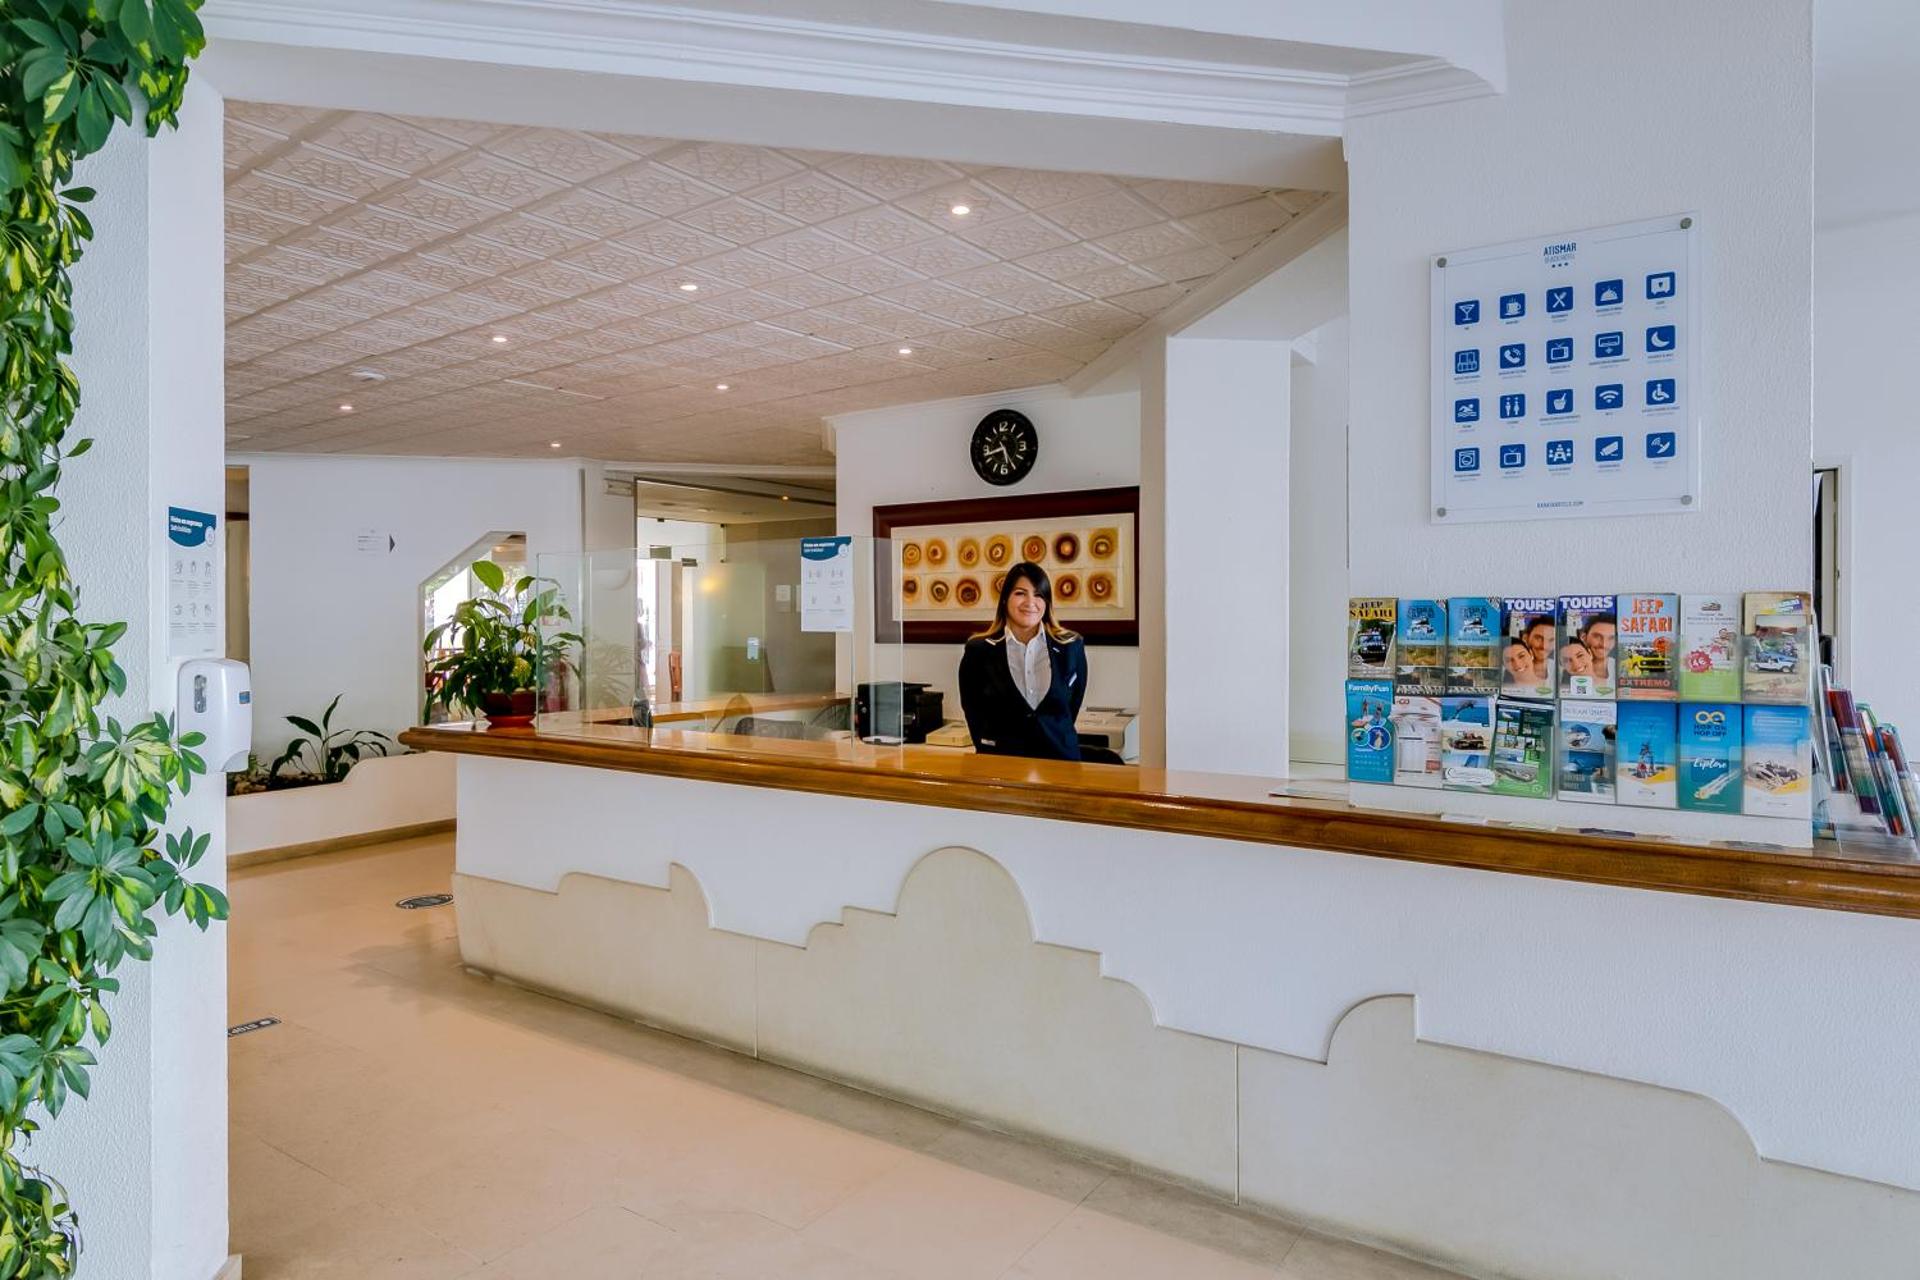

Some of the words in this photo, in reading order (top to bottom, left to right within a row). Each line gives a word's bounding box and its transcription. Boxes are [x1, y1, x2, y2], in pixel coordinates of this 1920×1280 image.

[1544, 242, 1577, 256] ATISMAR
[999, 421, 1009, 432] 12
[1019, 441, 1027, 452] 3
[1000, 464, 1009, 475] 6
[1359, 601, 1383, 610] JEEP
[1505, 599, 1555, 611] TOURS
[1560, 596, 1614, 609] TOURS
[1632, 599, 1664, 615] JEEP
[1349, 609, 1393, 618] SAFARI
[1621, 616, 1673, 633] SAFARI
[1348, 684, 1390, 693] FamilyFun
[1619, 678, 1671, 688] EXTREMO
[1693, 757, 1728, 770] Explore
